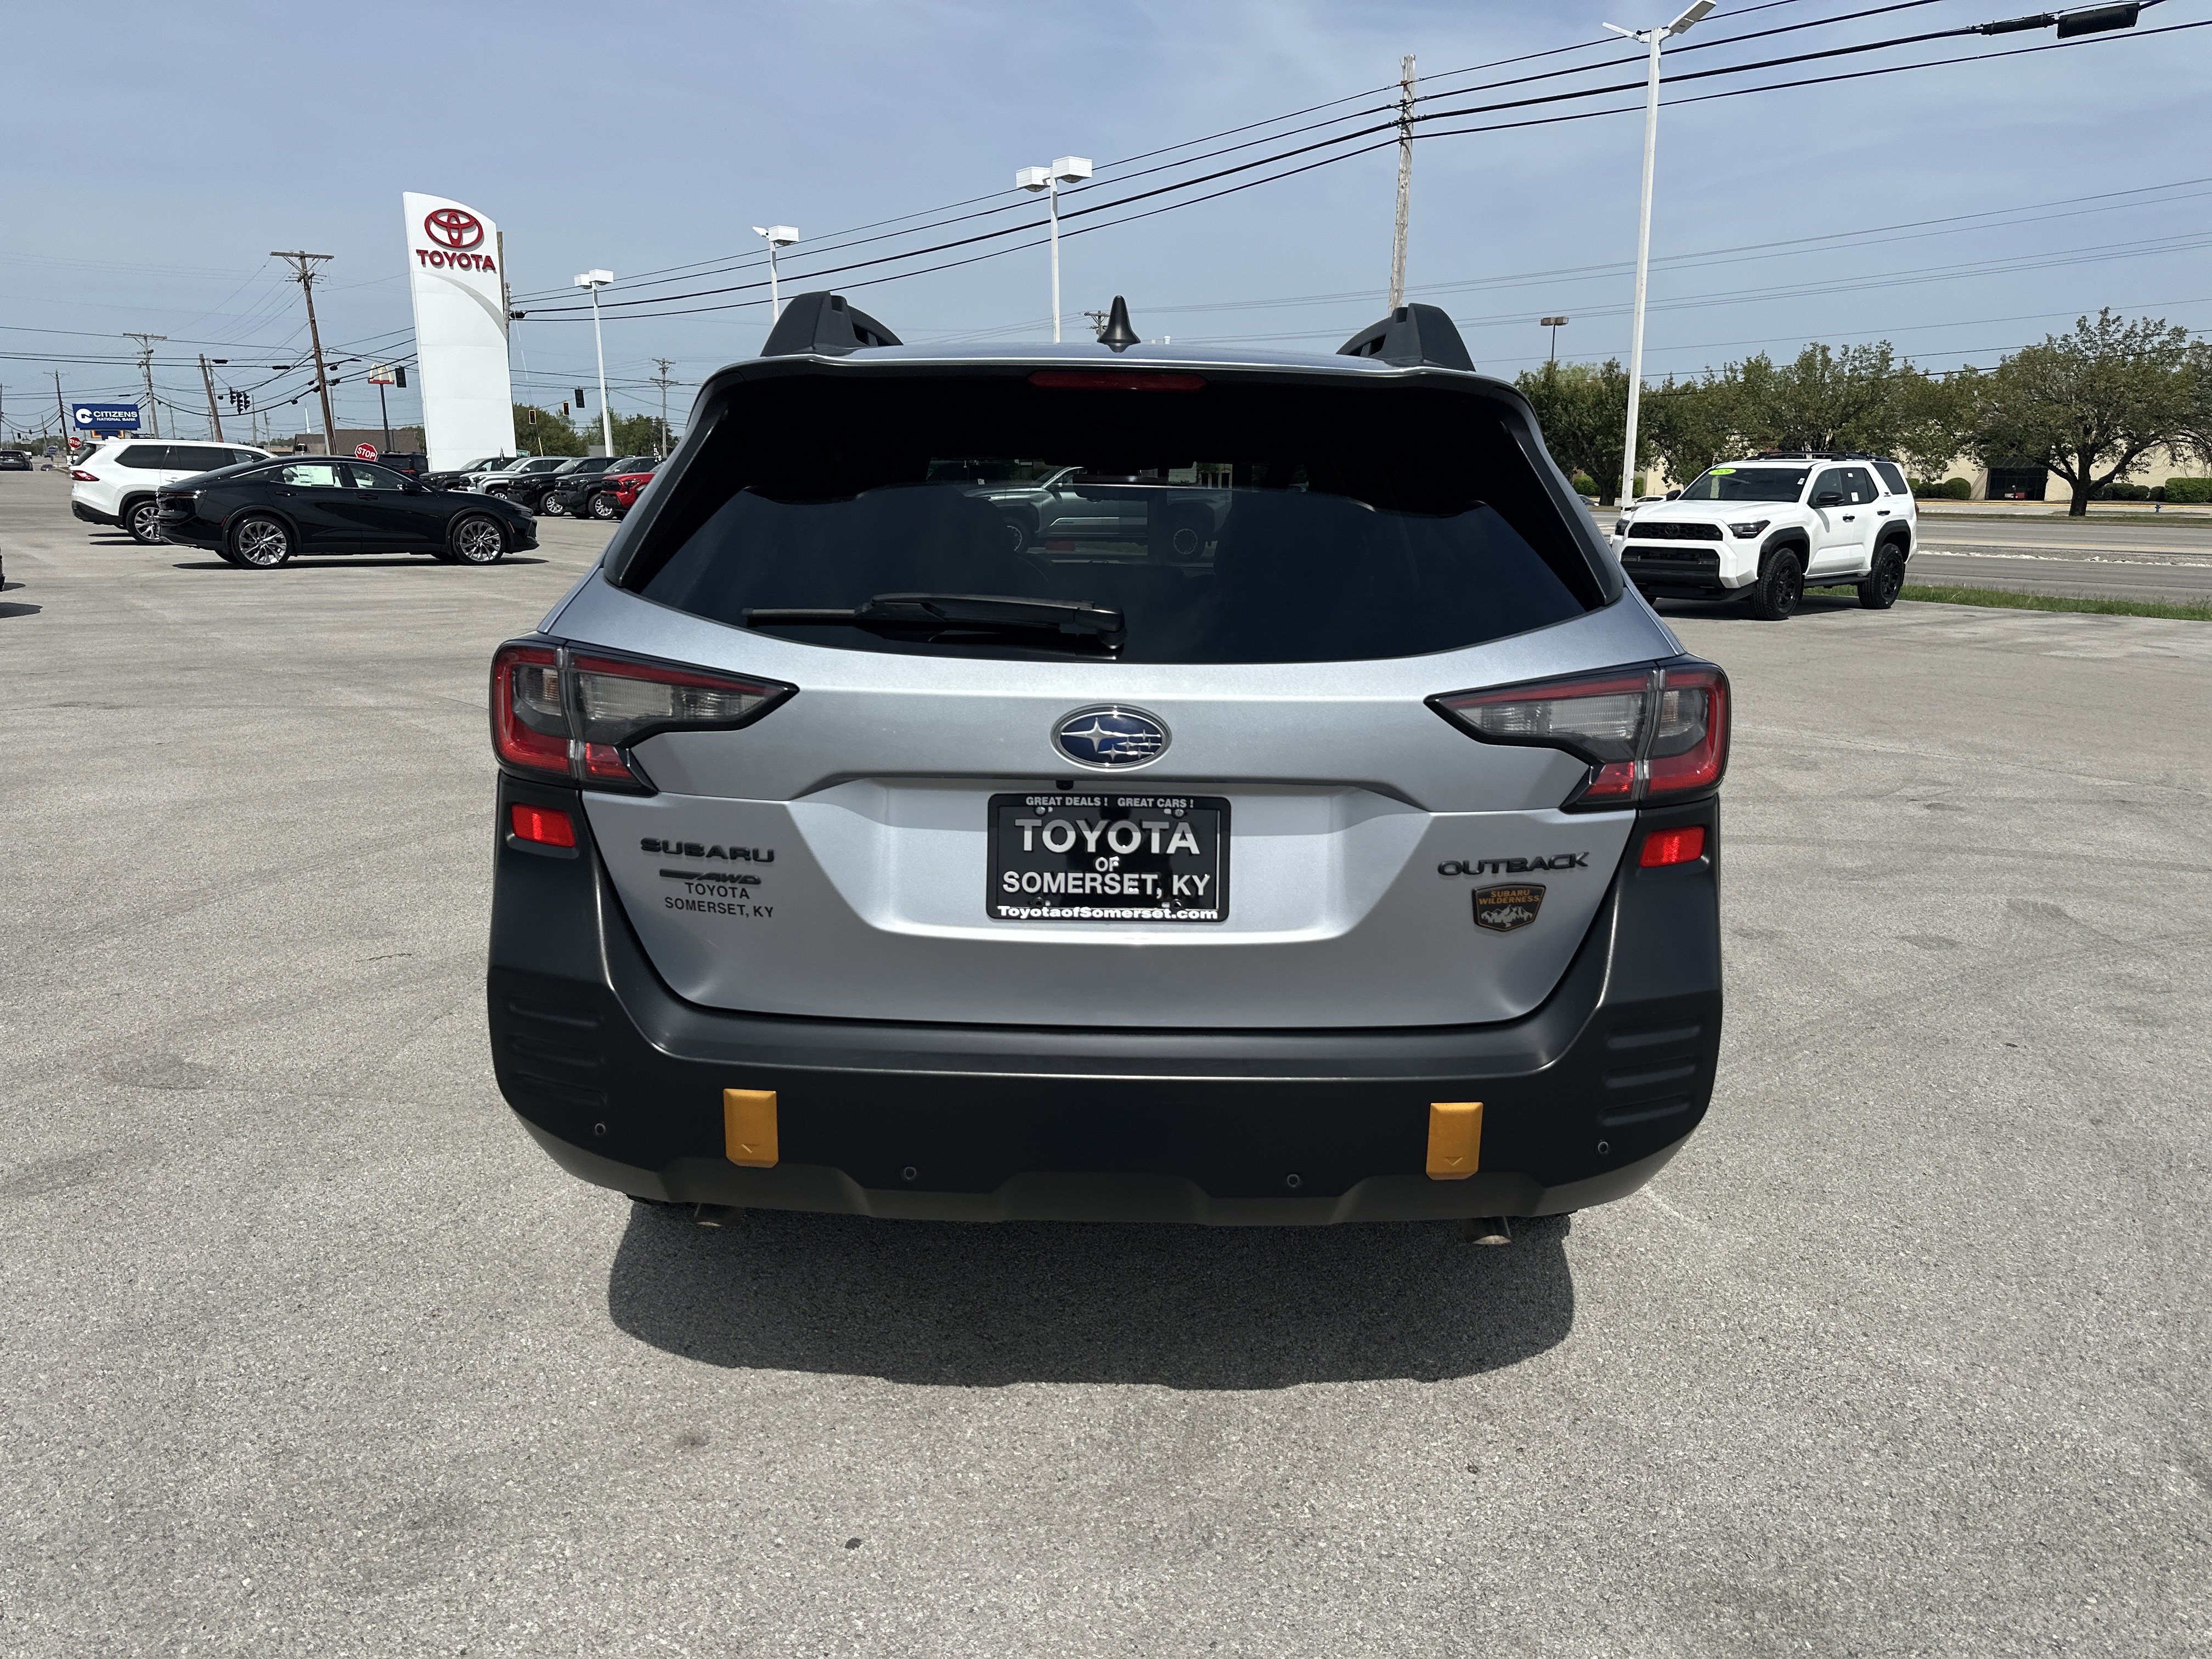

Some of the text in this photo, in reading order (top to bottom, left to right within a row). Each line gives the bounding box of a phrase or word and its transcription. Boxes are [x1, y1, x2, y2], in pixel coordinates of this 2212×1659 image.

[416, 249, 496, 270] TOYOTA
[357, 447, 376, 459] STOP
[1025, 796, 1062, 806] GREAT
[1065, 797, 1101, 806] DEALS
[1117, 797, 1154, 808] GREAT
[1156, 798, 1187, 808] CARS
[1015, 819, 1200, 854] TOYOTA
[640, 837, 775, 862] SUBARU
[1095, 856, 1119, 872] OF
[1437, 852, 1589, 876] OUTBACK
[697, 872, 762, 885] AWD
[1002, 871, 1210, 899] SOMERSET, KY
[685, 882, 751, 900] TOYOTA
[1479, 894, 1541, 905] WILDERNESS
[1490, 889, 1531, 898] SUBARU
[664, 896, 774, 918] SOMERSET, KY
[997, 905, 1218, 919] ToyotaofSomerset.com
